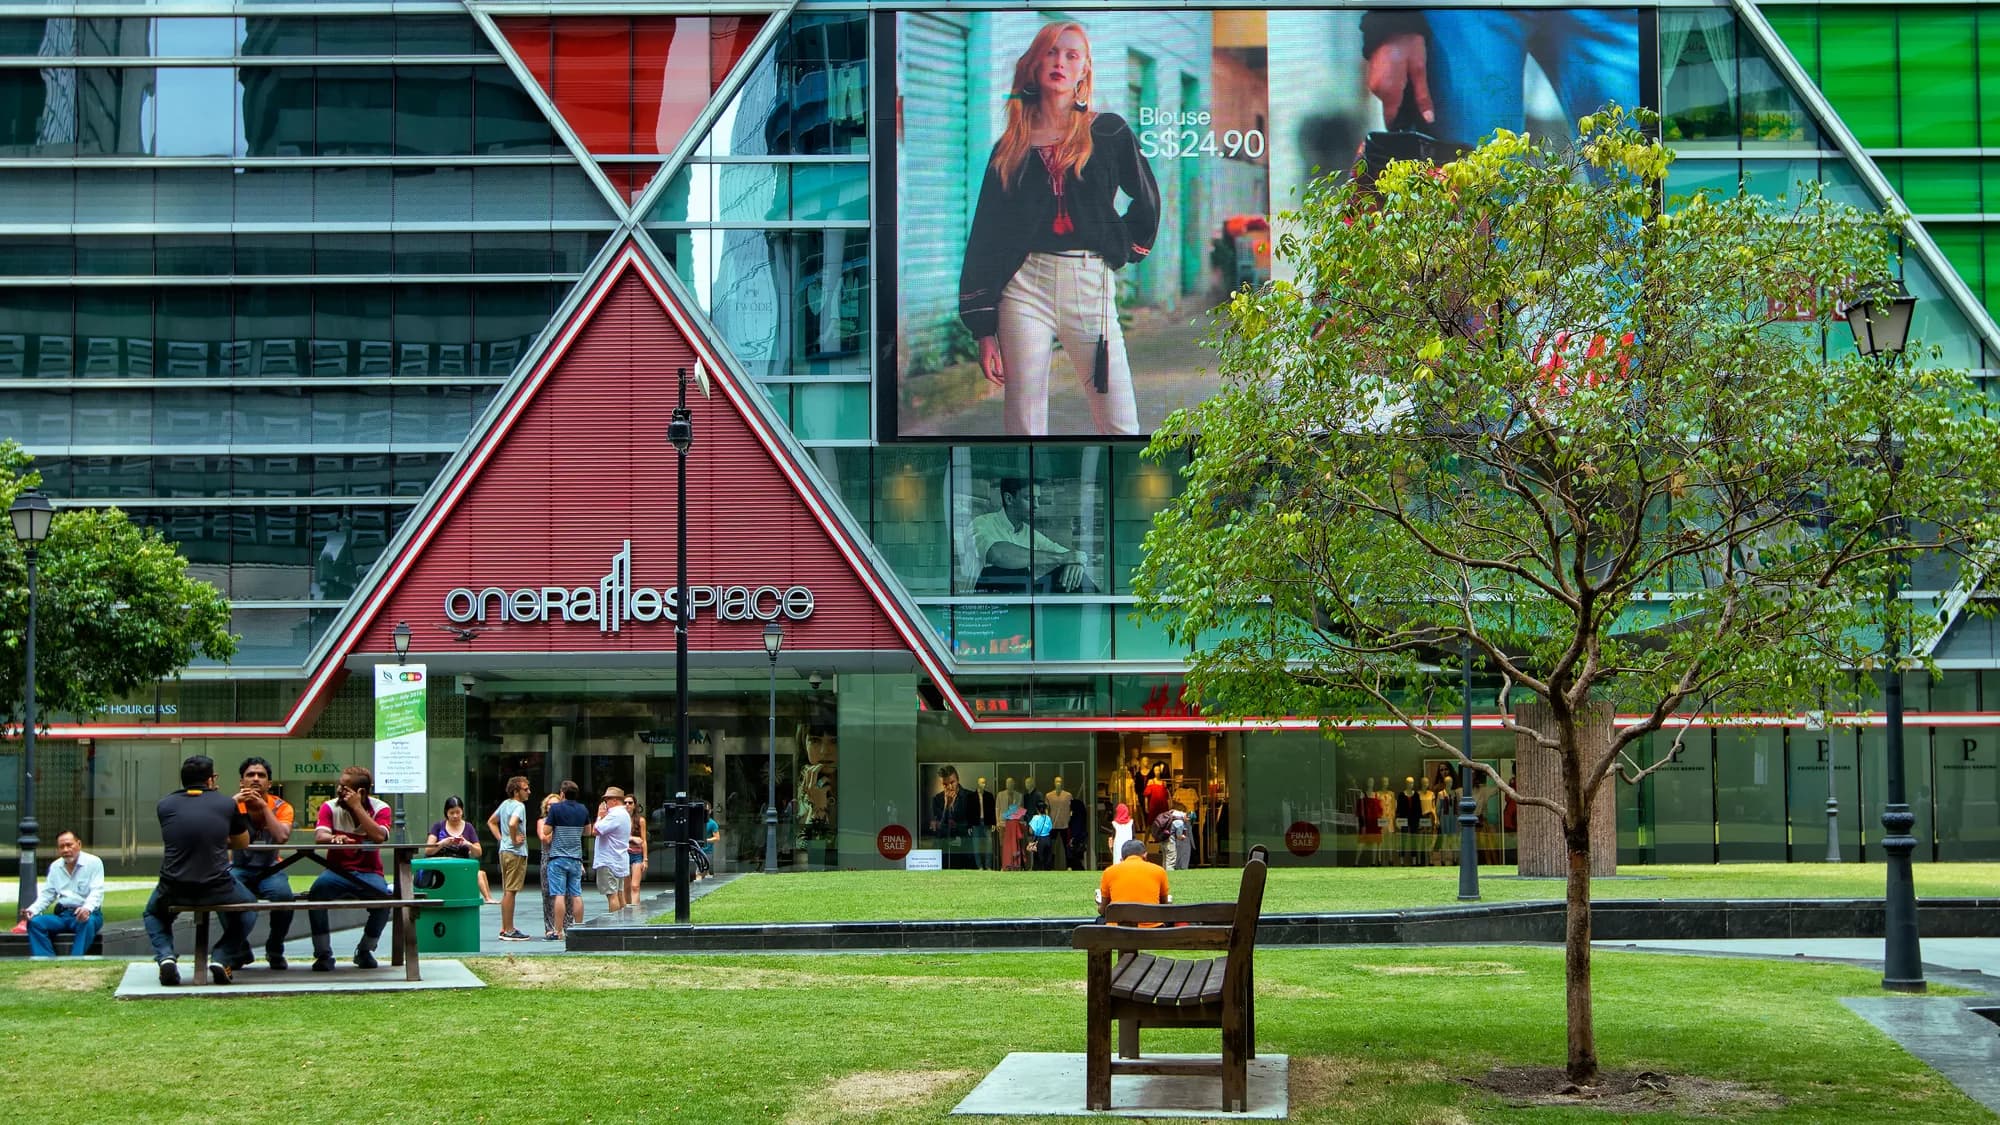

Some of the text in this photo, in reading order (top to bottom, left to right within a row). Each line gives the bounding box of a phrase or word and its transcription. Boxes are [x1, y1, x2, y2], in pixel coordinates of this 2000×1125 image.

[1139, 107, 1212, 126] Blouse
[1139, 127, 1266, 160] S$24.90
[111, 704, 142, 714] HOUR
[294, 763, 341, 773] ROLEX
[882, 835, 907, 843] FINAL
[1290, 831, 1314, 840] FINAL
[1292, 839, 1313, 847] SALE
